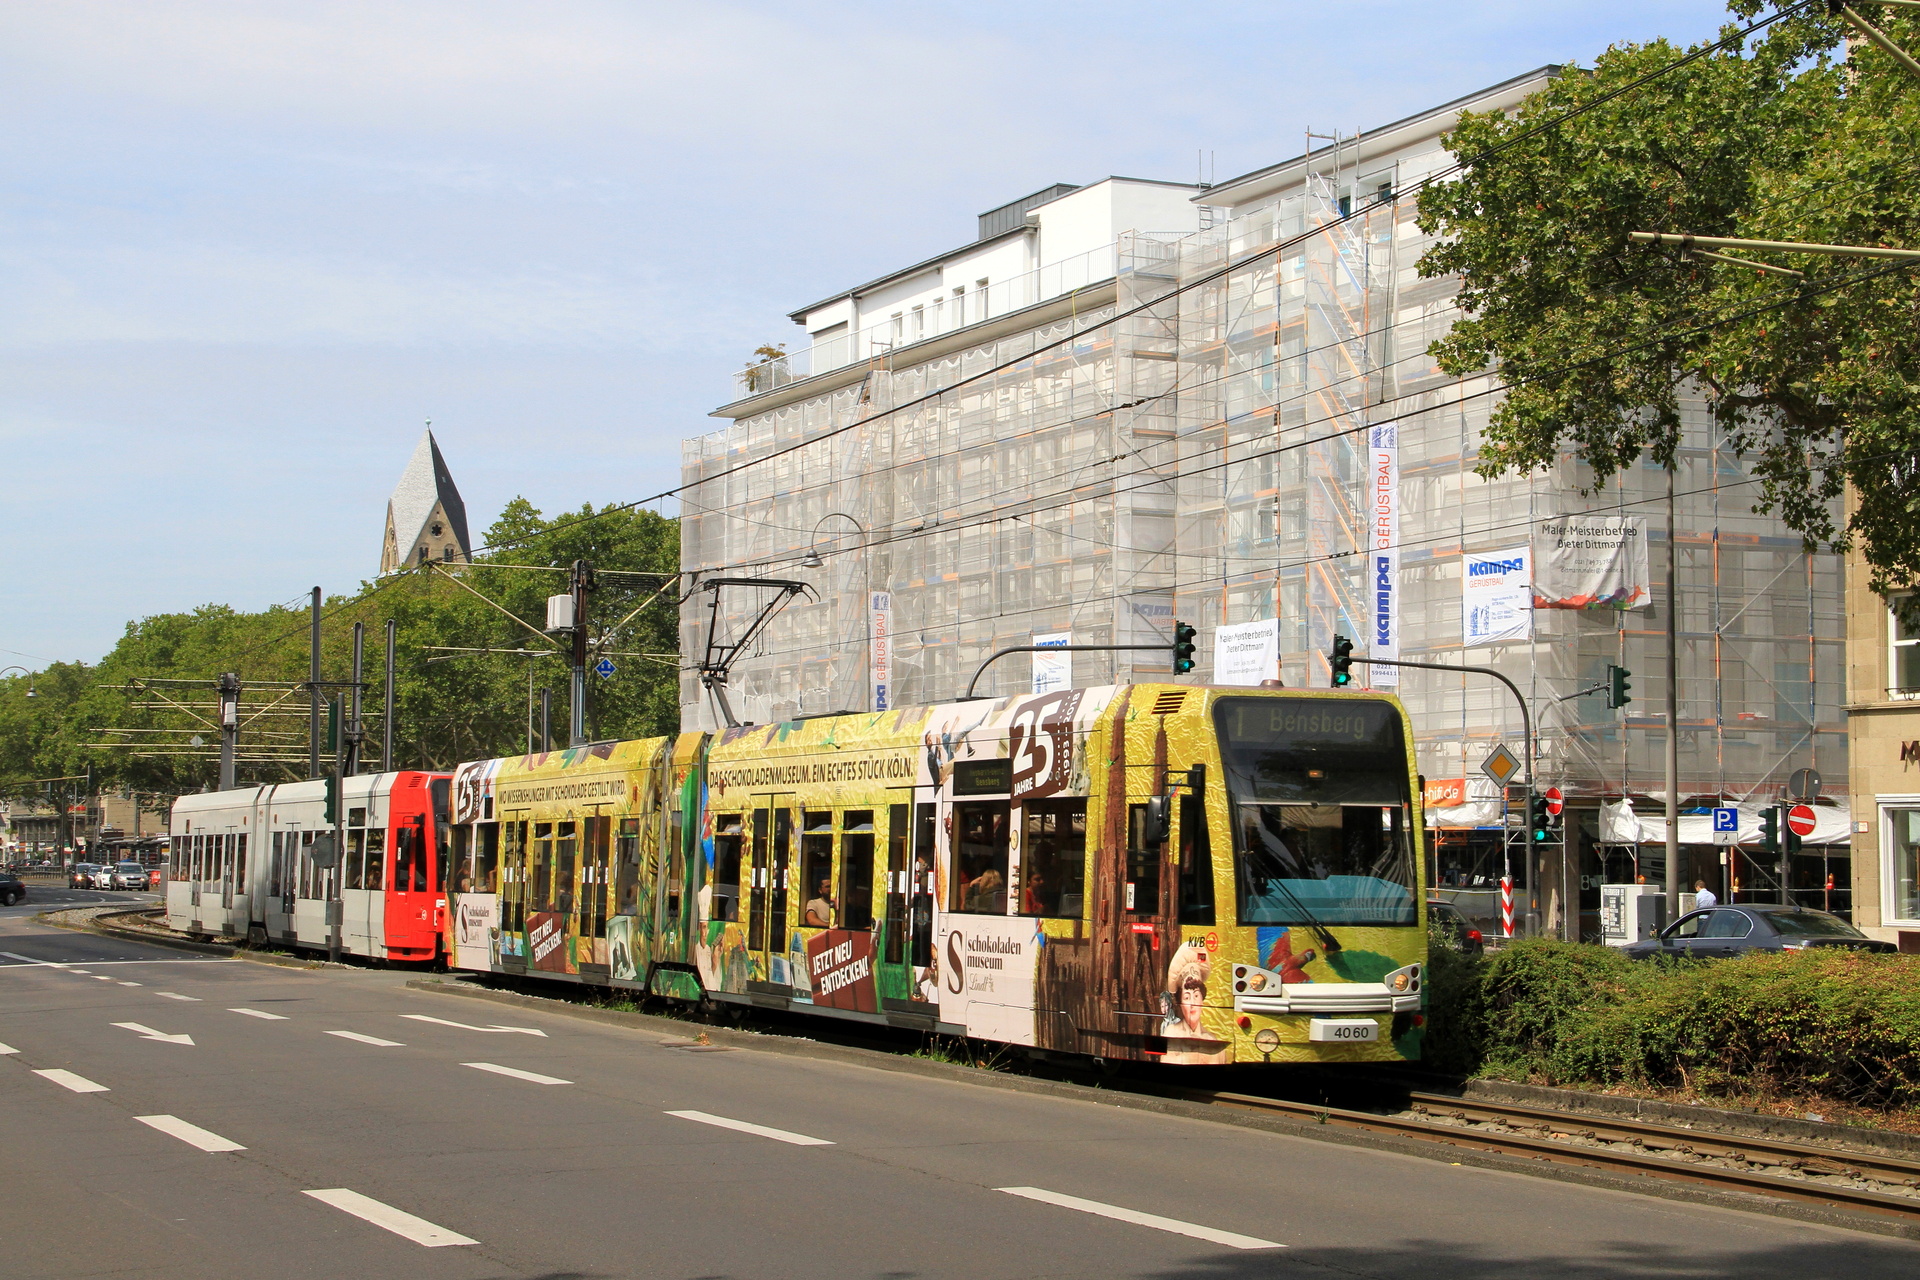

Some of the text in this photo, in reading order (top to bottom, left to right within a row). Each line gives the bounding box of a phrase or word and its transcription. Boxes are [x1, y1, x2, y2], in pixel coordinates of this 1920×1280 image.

[1375, 454, 1391, 549] GERÜSTBAU
[1542, 524, 1637, 537] Maler-Meisterbetrieb
[1558, 539, 1626, 549] Dieter Dittmann
[1469, 558, 1523, 576] kampa
[1469, 578, 1504, 588] GERÜSTBAU
[1377, 557, 1391, 645] kampa
[876, 613, 886, 681] GERÜSTBAU
[1237, 706, 1366, 740] 1 Bensberg
[1013, 699, 1062, 788] 25
[723, 765, 811, 788] SCHOKOLADENMUSEUM.
[812, 764, 826, 782] EIN
[827, 761, 857, 782] ECHTES
[858, 755, 886, 780] STÜCK
[886, 753, 913, 778] KÖLN.
[555, 783, 587, 800] SCHOKOLADE
[1014, 777, 1034, 796] JAHRE
[1717, 811, 1731, 829] P
[967, 934, 1021, 955] schokoladen
[1188, 936, 1206, 948] KVB
[812, 939, 852, 976] JETZT NEU
[967, 955, 1003, 970] museum
[820, 955, 869, 996] ENTDECKEN!
